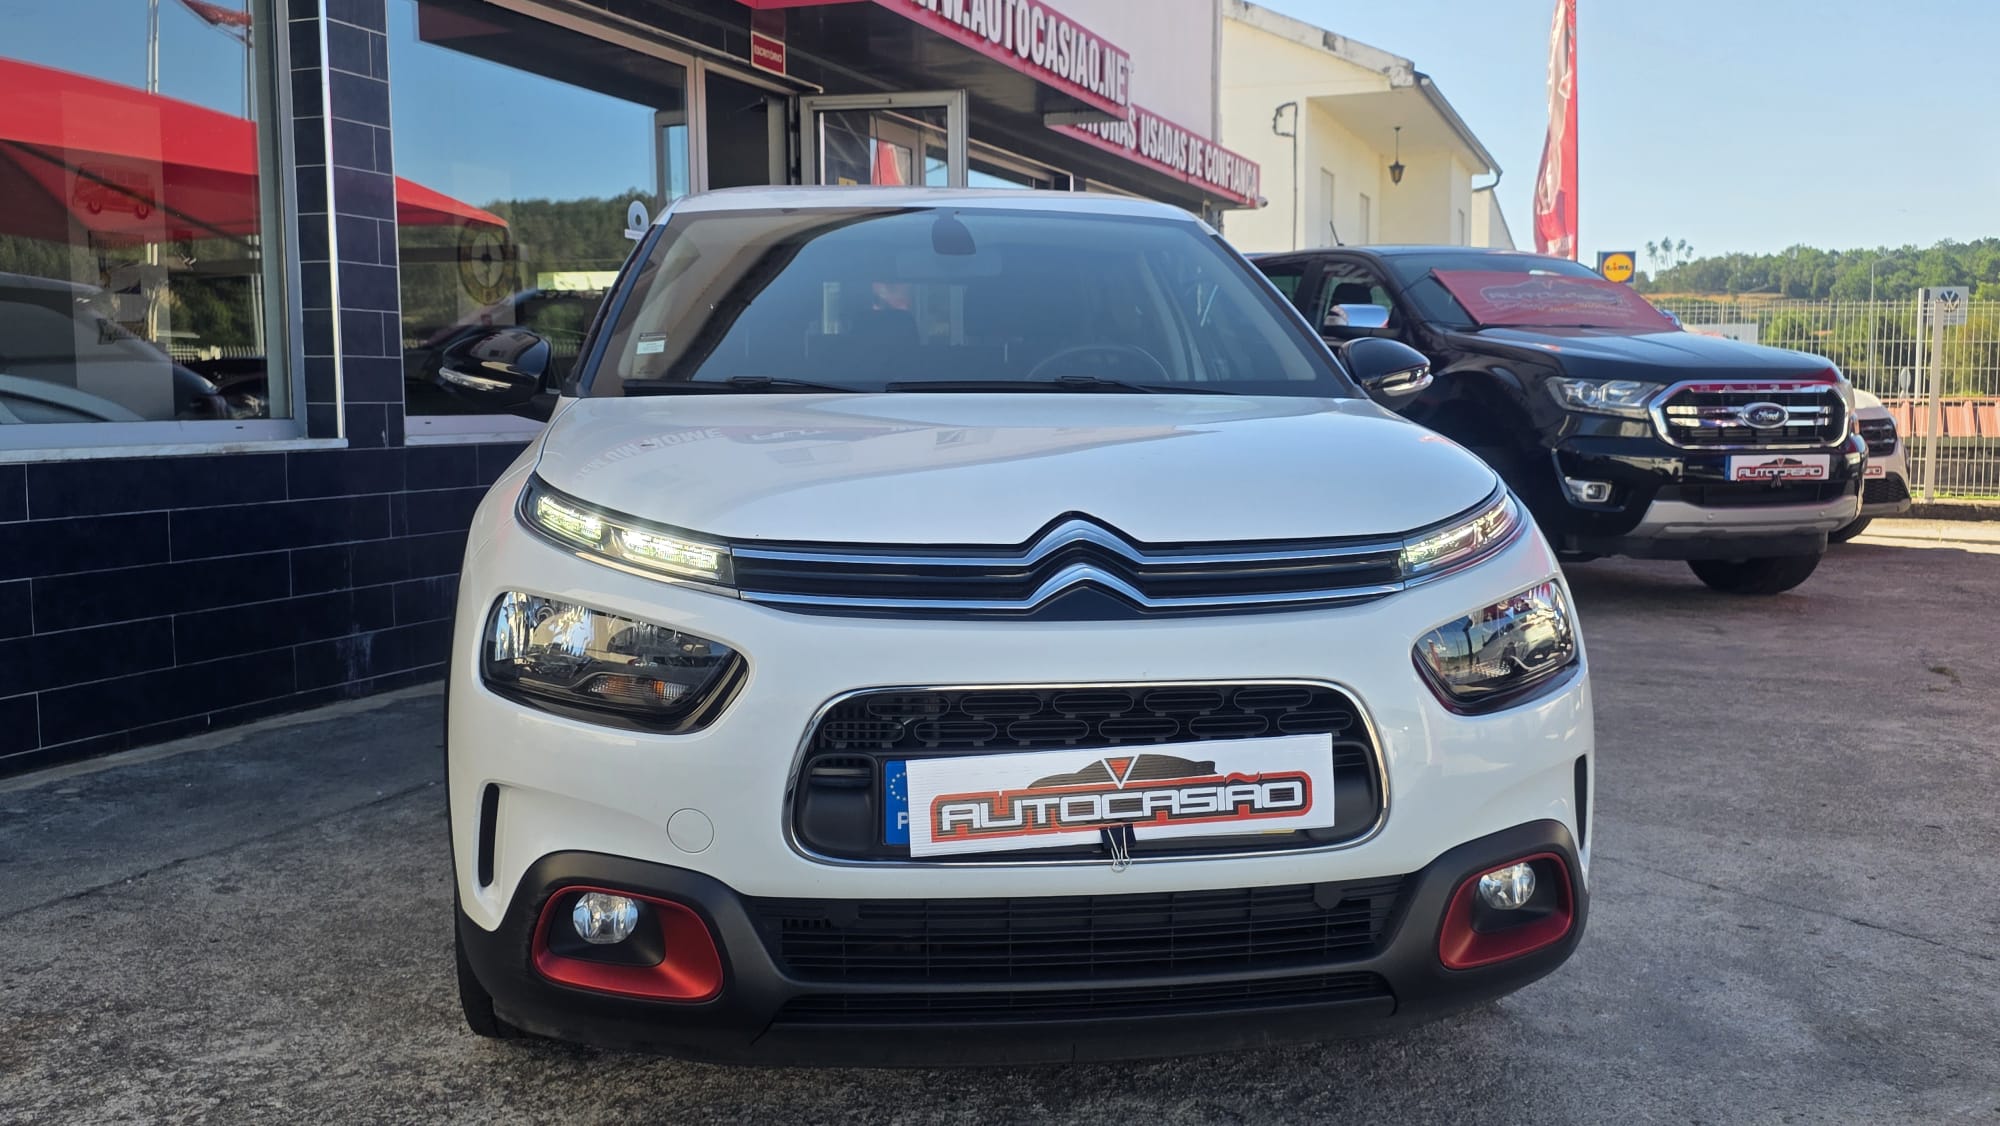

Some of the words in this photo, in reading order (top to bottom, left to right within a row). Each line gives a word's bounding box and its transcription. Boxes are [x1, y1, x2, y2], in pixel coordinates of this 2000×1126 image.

[916, 0, 1134, 108] .AUTOCASIAO.NET
[1140, 113, 1187, 171] USADAS
[1188, 136, 1203, 177] DE
[1204, 143, 1258, 204] CONFIANÇA
[941, 773, 1304, 831] AUTOCASIÃO
